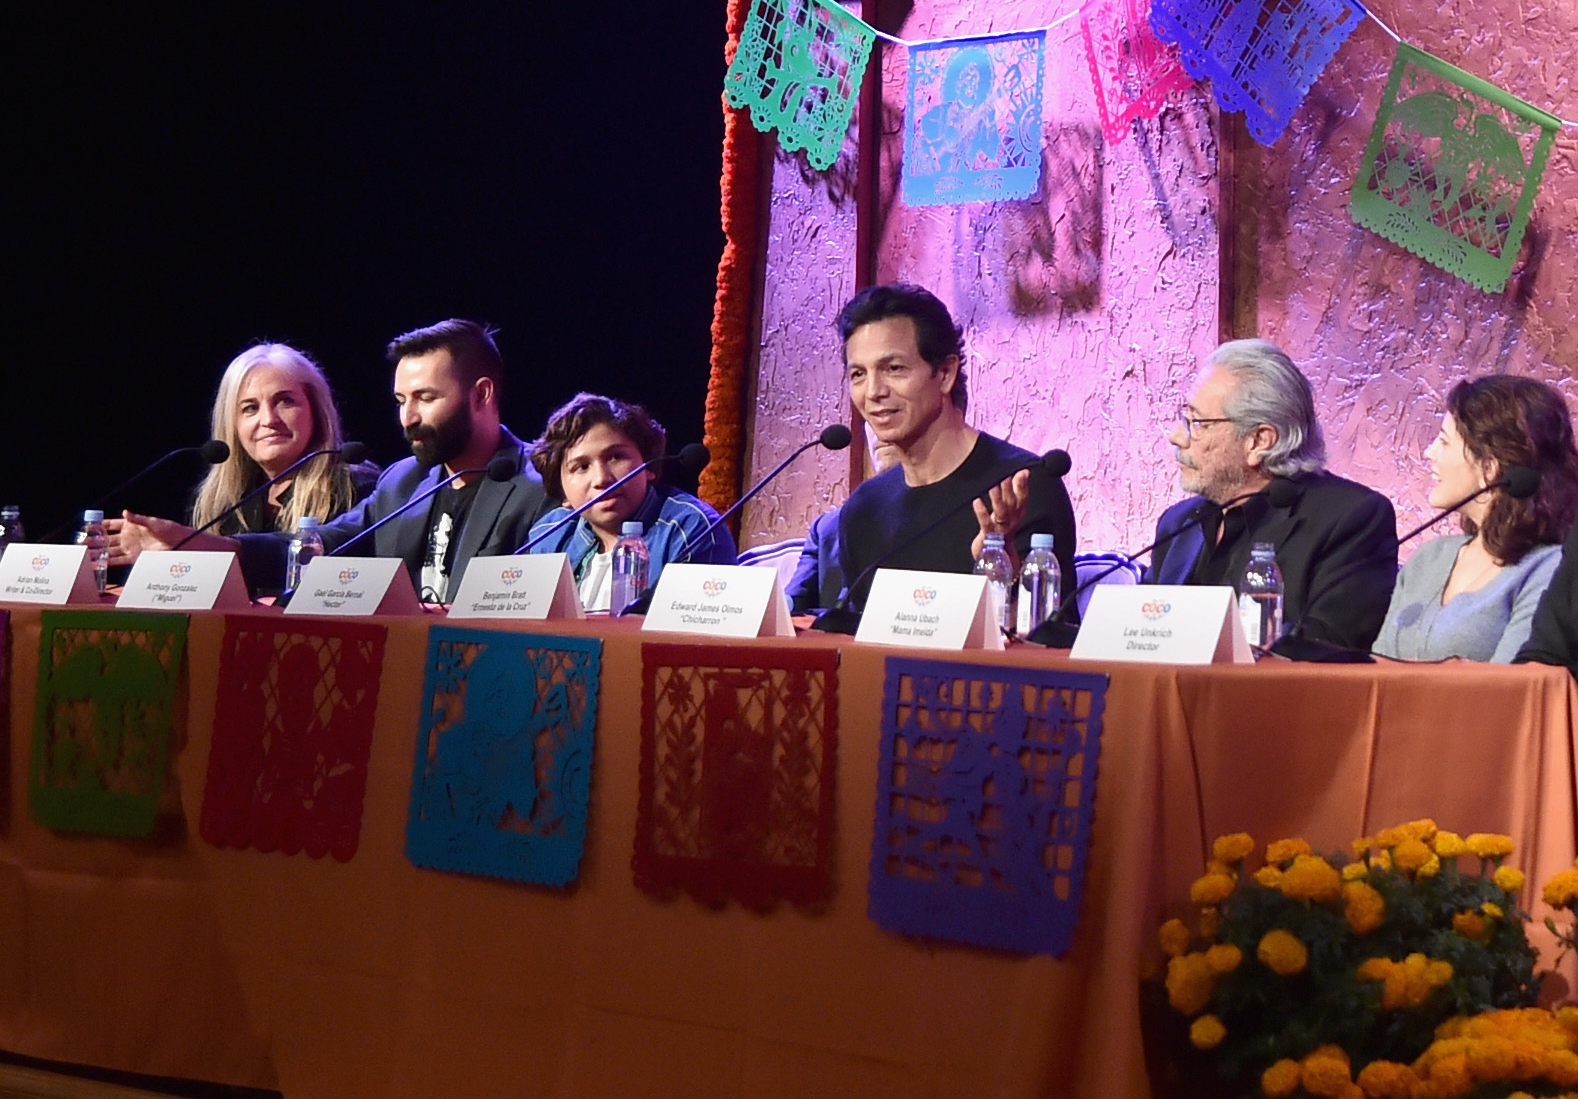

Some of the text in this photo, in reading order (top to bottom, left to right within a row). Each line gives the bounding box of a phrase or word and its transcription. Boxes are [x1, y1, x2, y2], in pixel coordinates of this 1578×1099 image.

[170, 564, 191, 573] COCO
[339, 570, 359, 579] COCO
[501, 569, 523, 579] COCO
[146, 583, 170, 592] Anthony
[703, 580, 727, 591] COCO
[345, 590, 365, 598] Bernal
[483, 590, 526, 601] Benjamin Bratt
[913, 589, 937, 599] COCO
[497, 603, 505, 611] de
[506, 602, 512, 610] la
[671, 601, 697, 611] Edward
[697, 602, 719, 612] James
[1142, 602, 1171, 613] COCO
[895, 612, 918, 622] Alanna
[1123, 627, 1172, 638] Lee Unkrich
[1126, 640, 1160, 651] Director
